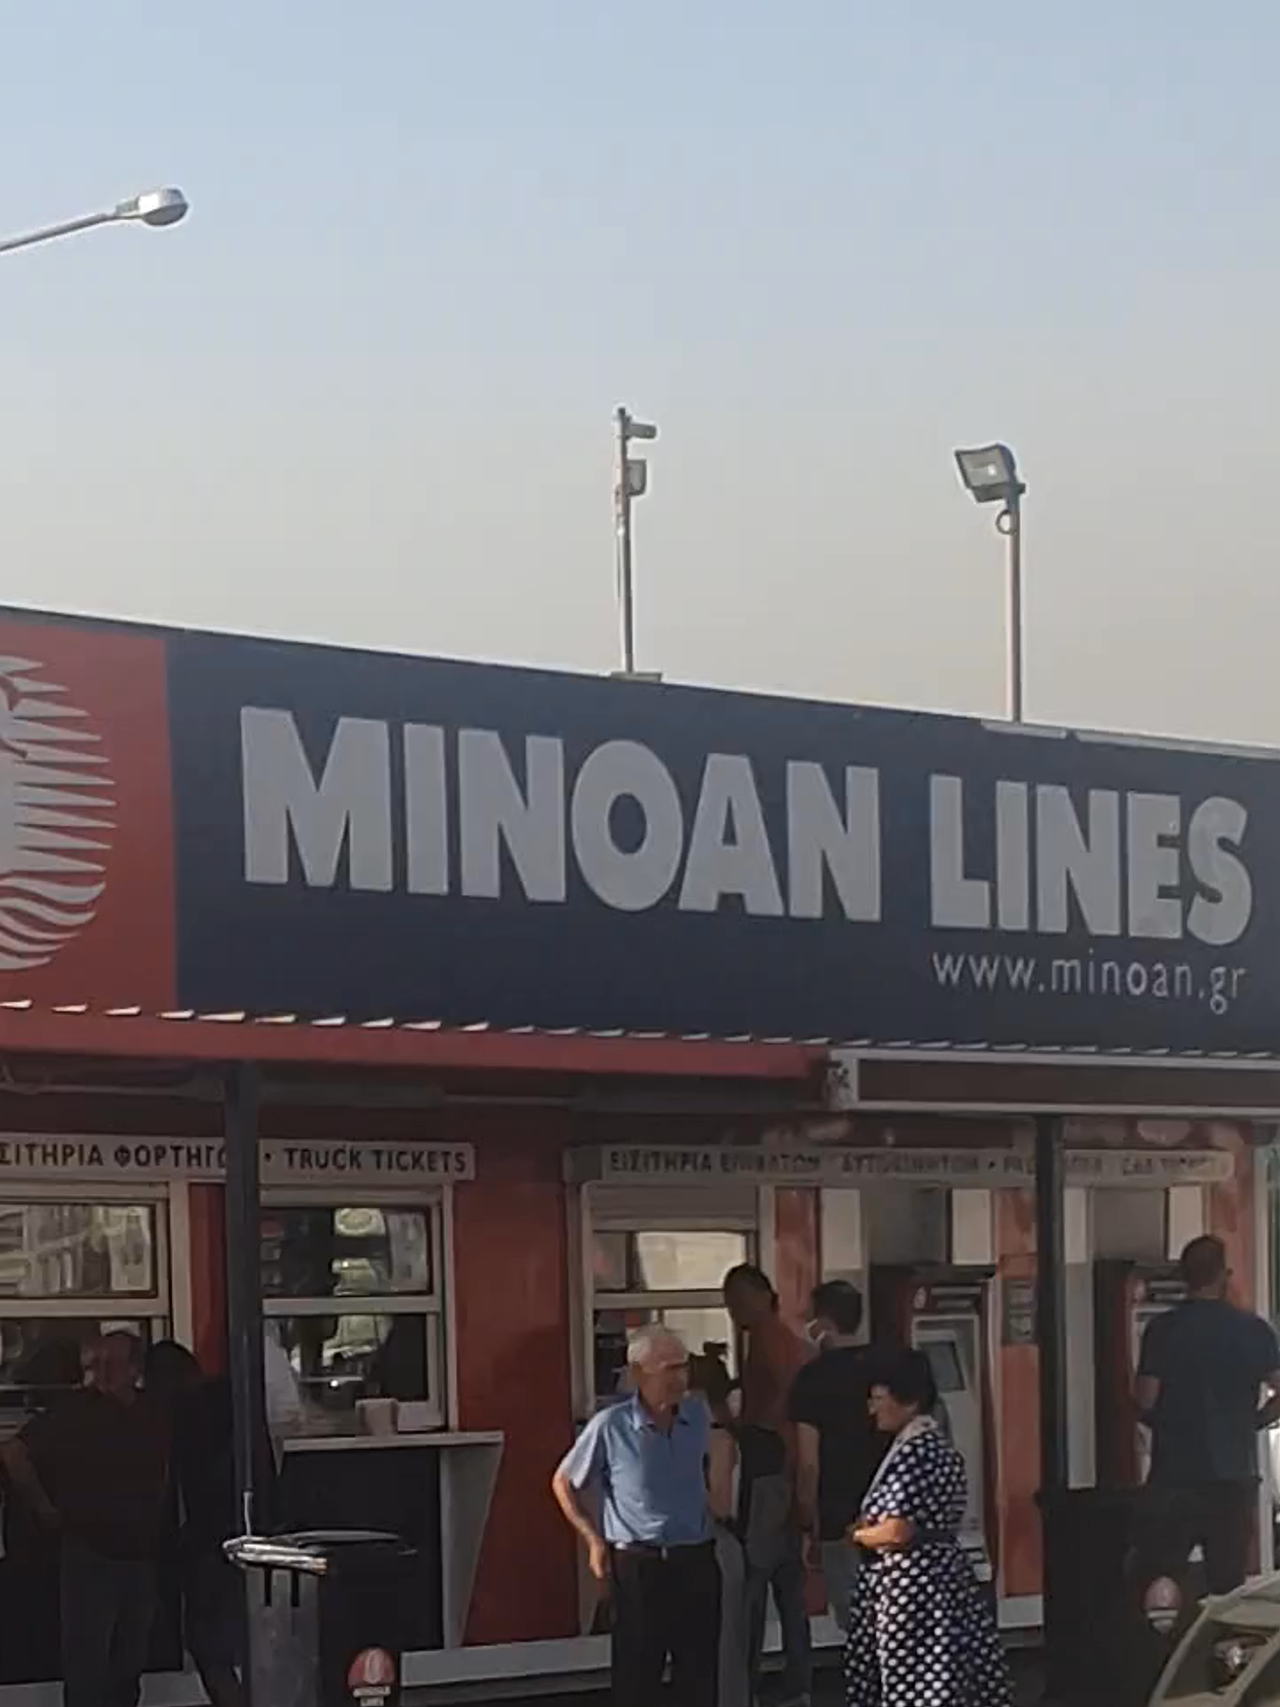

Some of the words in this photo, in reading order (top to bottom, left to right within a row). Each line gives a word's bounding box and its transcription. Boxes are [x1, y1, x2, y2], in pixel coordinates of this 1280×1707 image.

[239, 705, 881, 922] MINOAN
[929, 773, 1253, 946] LINES
[932, 948, 1246, 1015] www.minoan.gr
[284, 1147, 362, 1171] TRUCK
[372, 1149, 466, 1173] TICKETS
